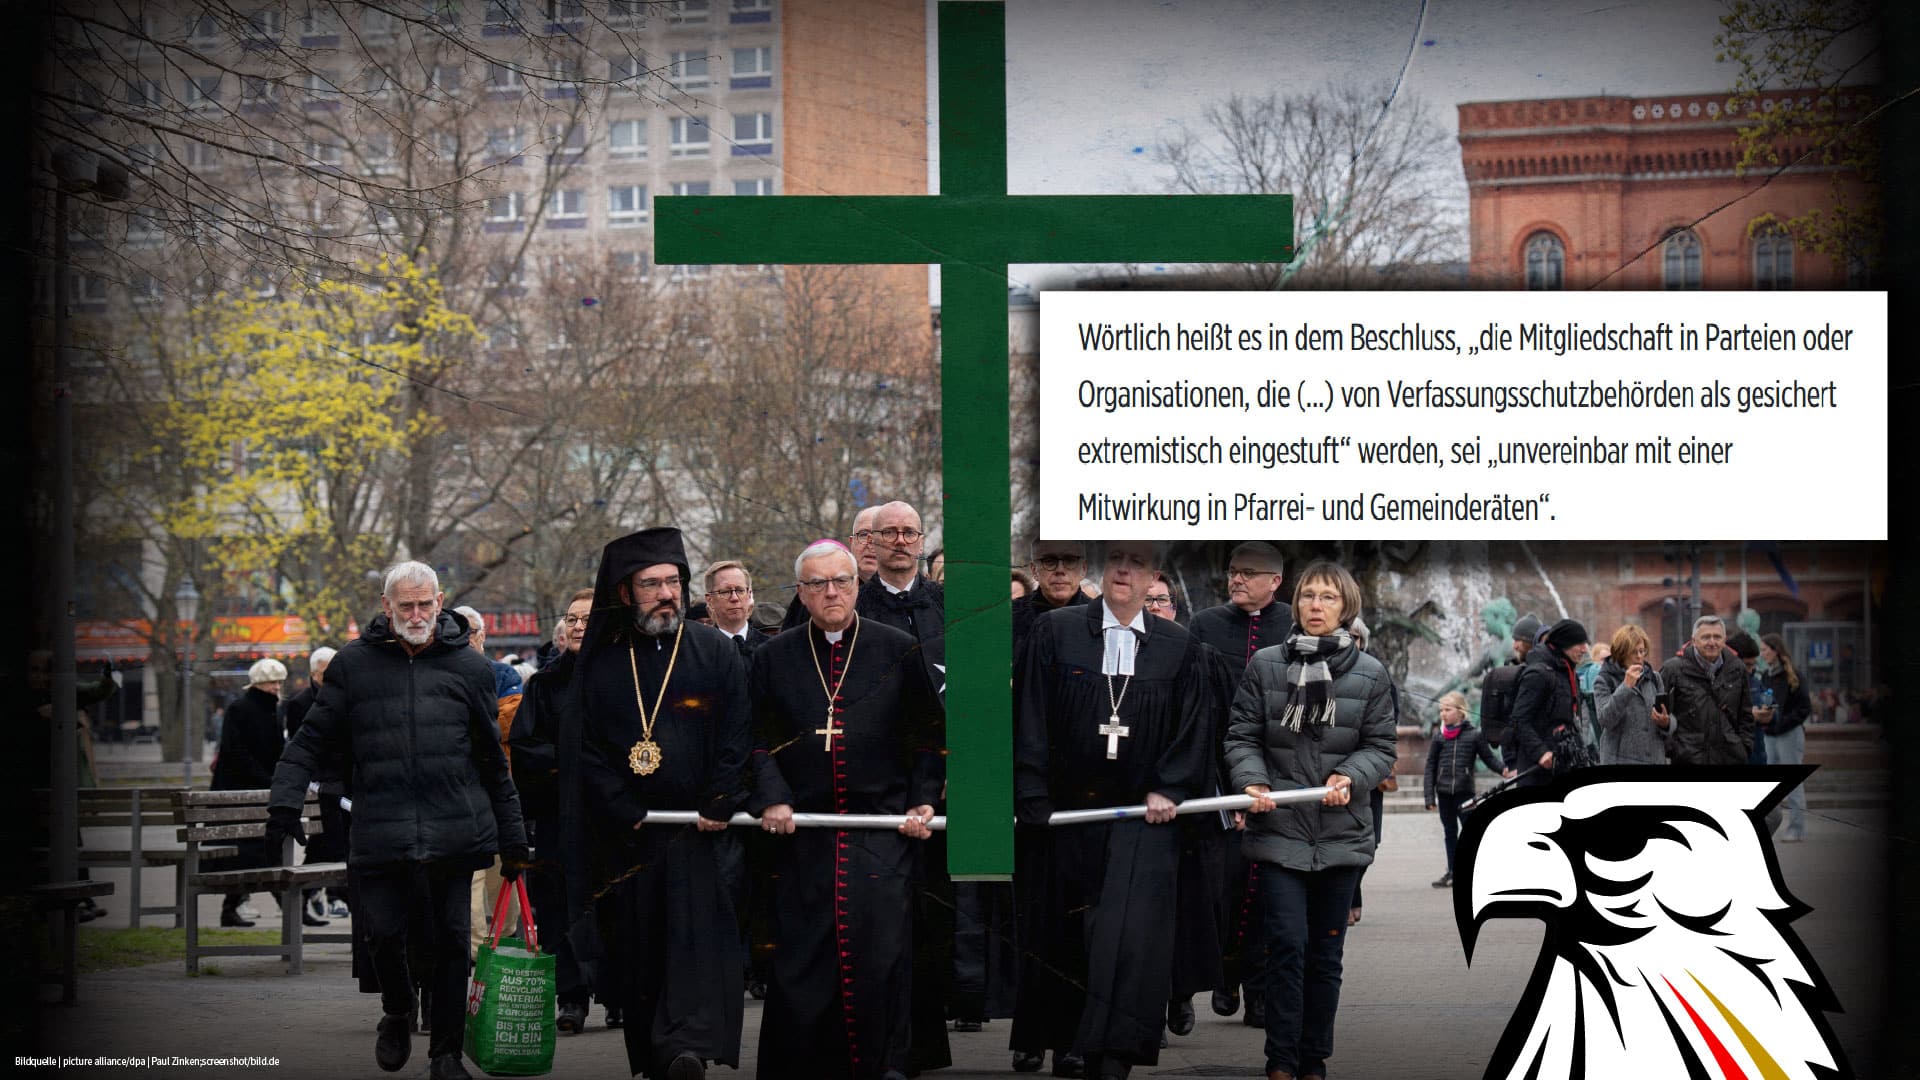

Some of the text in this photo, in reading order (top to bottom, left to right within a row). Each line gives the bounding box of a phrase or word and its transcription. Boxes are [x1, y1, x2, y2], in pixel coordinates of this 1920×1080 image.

[501, 976, 545, 985] AUS 70%
[497, 1008, 504, 1016] 2
[496, 1021, 513, 1031] BIS
[516, 1023, 526, 1032] 15
[495, 1031, 542, 1043] ICH BIN
